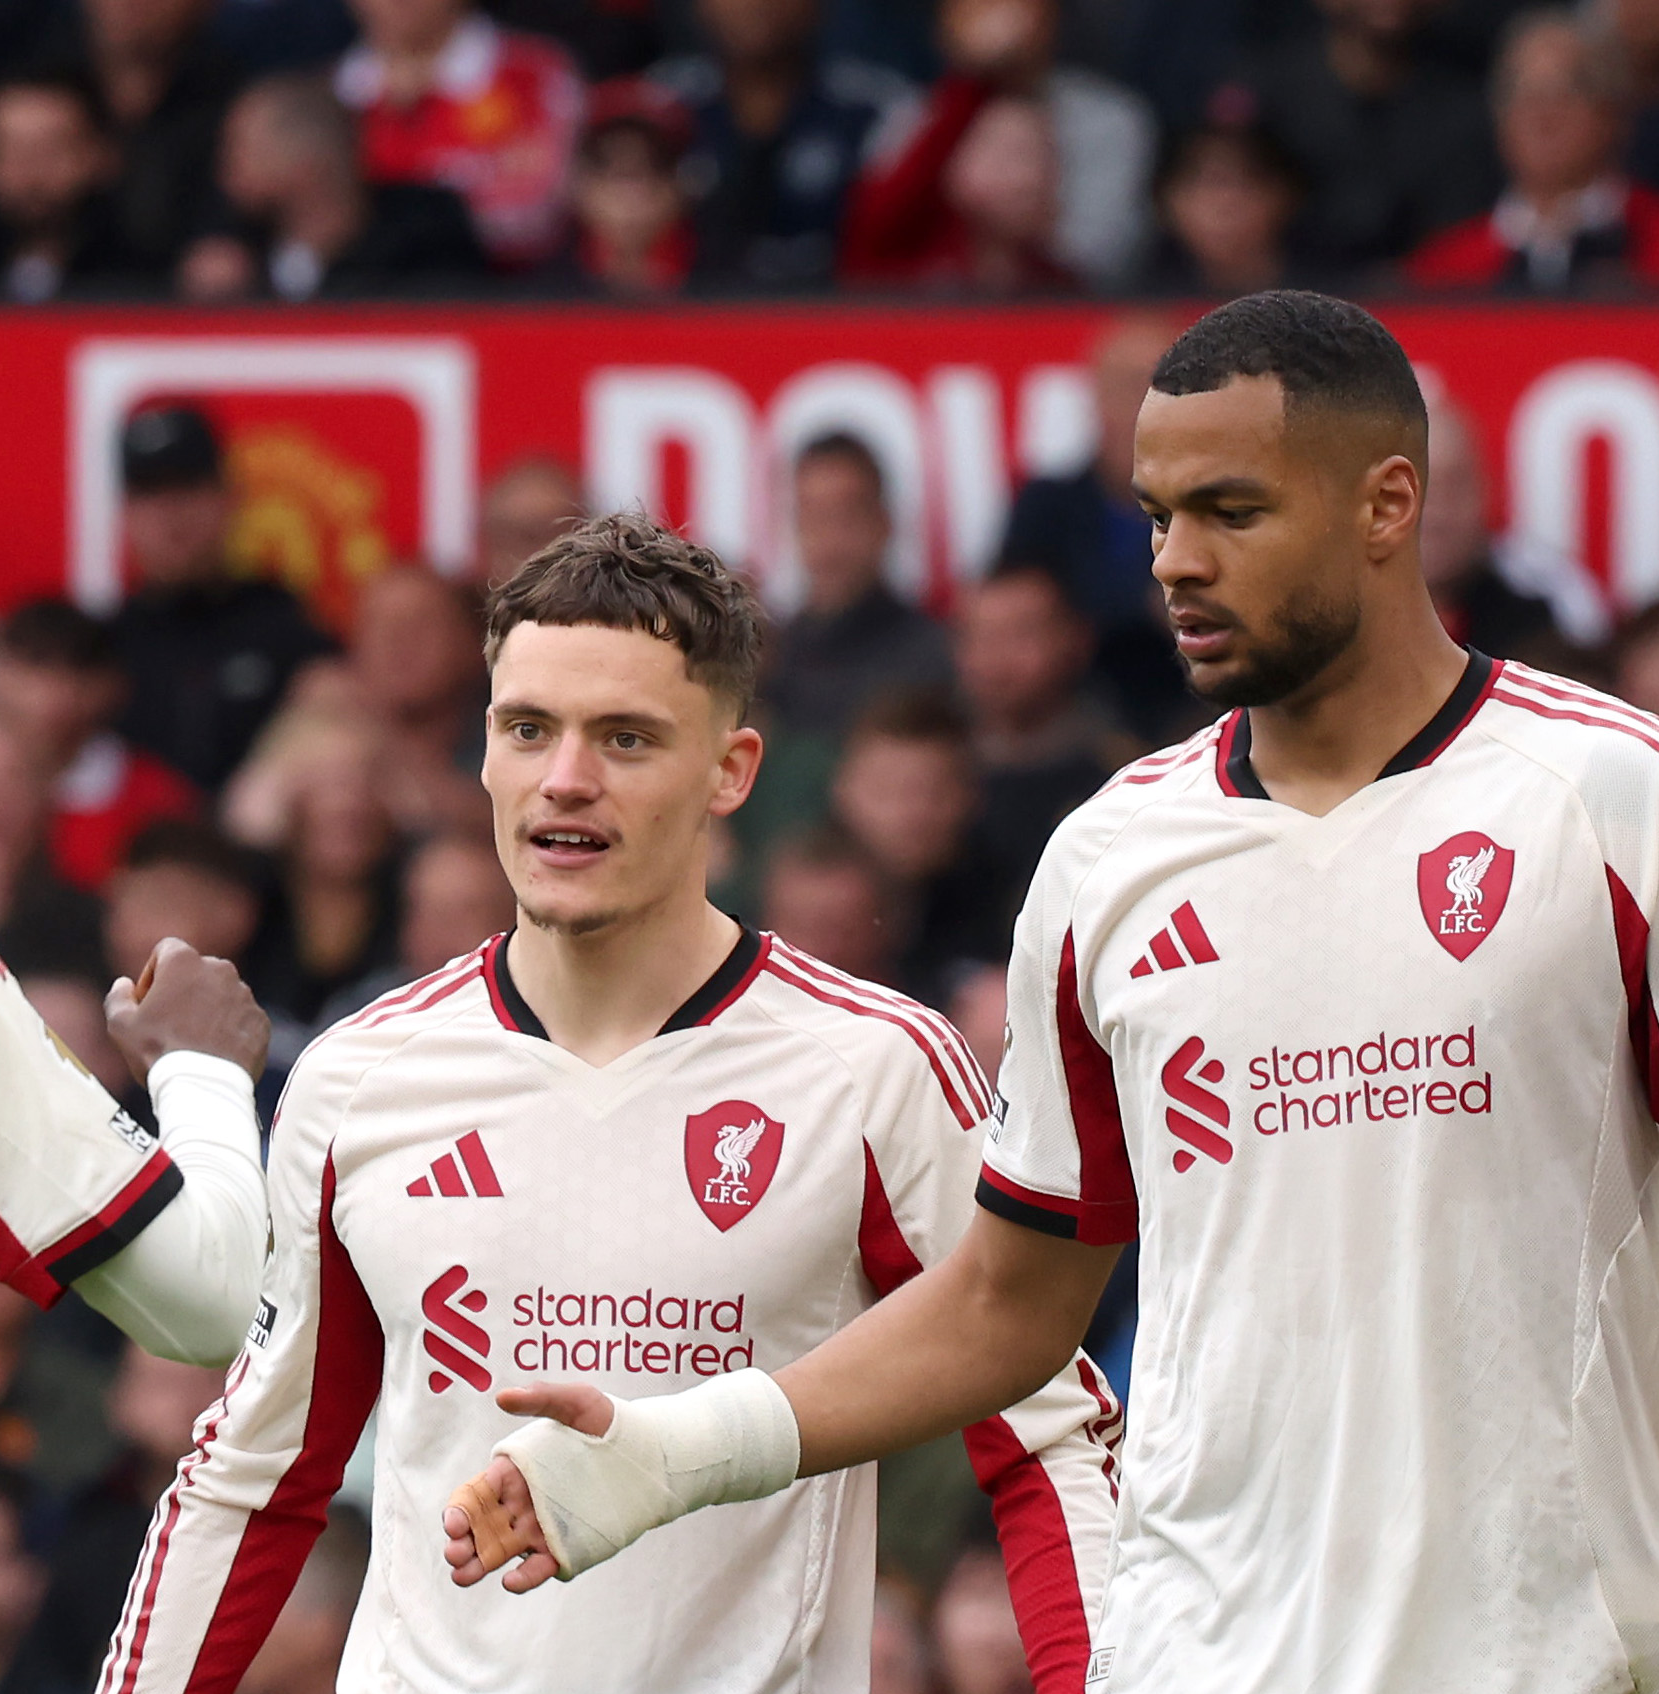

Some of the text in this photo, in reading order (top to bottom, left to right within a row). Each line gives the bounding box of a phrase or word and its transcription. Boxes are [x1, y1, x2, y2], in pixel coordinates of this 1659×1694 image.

[1248, 1024, 1476, 1091] standard
[1253, 1071, 1493, 1136] chartered
[512, 1285, 745, 1334] standard
[513, 1330, 755, 1377] chartered
